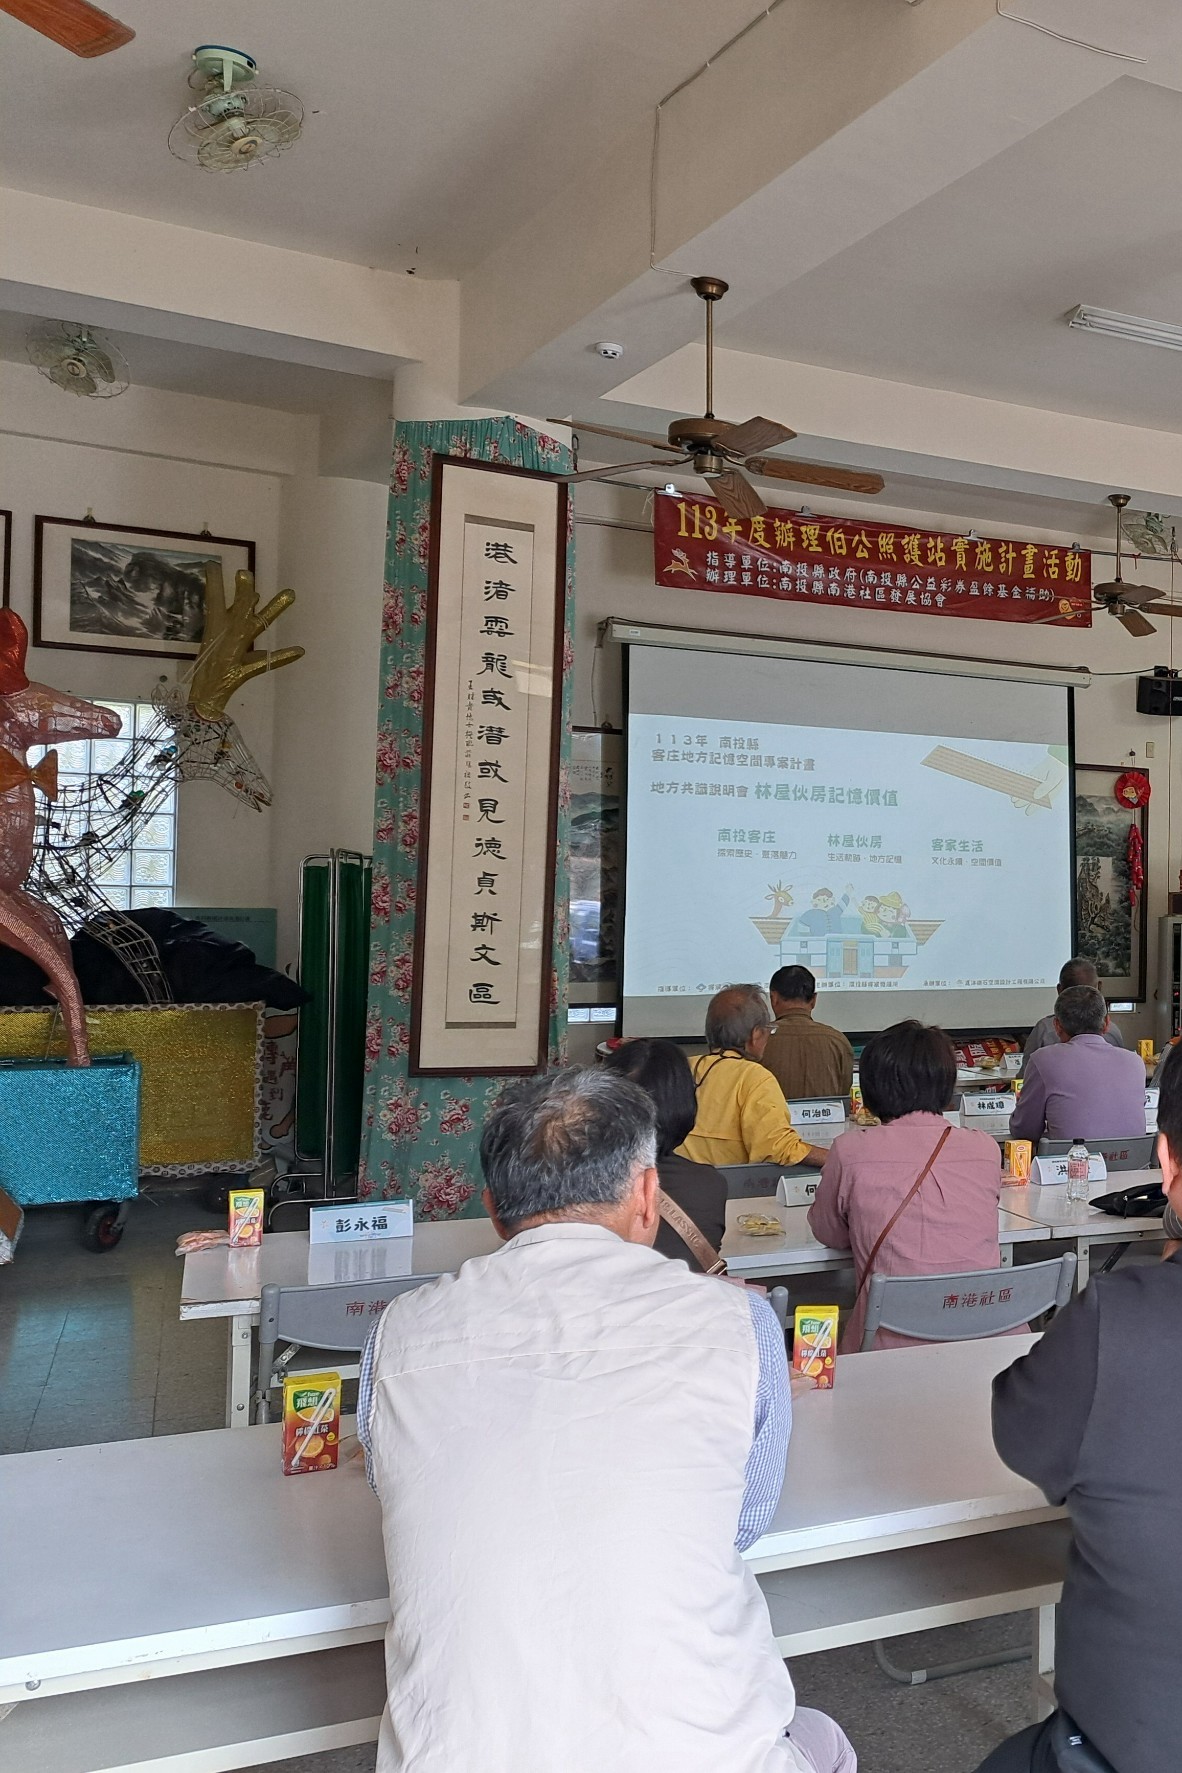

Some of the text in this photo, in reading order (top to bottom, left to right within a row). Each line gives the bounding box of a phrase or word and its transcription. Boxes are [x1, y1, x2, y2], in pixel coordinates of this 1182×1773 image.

[719, 736, 759, 750] 南投縣
[651, 749, 816, 771] 客庄地方記憶空間專案計畫
[650, 781, 898, 807] 地方共識說明會 林屋伙房記憶價值
[717, 828, 776, 844] 南投客庄
[827, 834, 882, 849] 林屋伙房
[931, 838, 984, 853] 客家生活
[335, 1216, 388, 1233] 彭永福
[943, 1288, 1013, 1309] 南港社區
